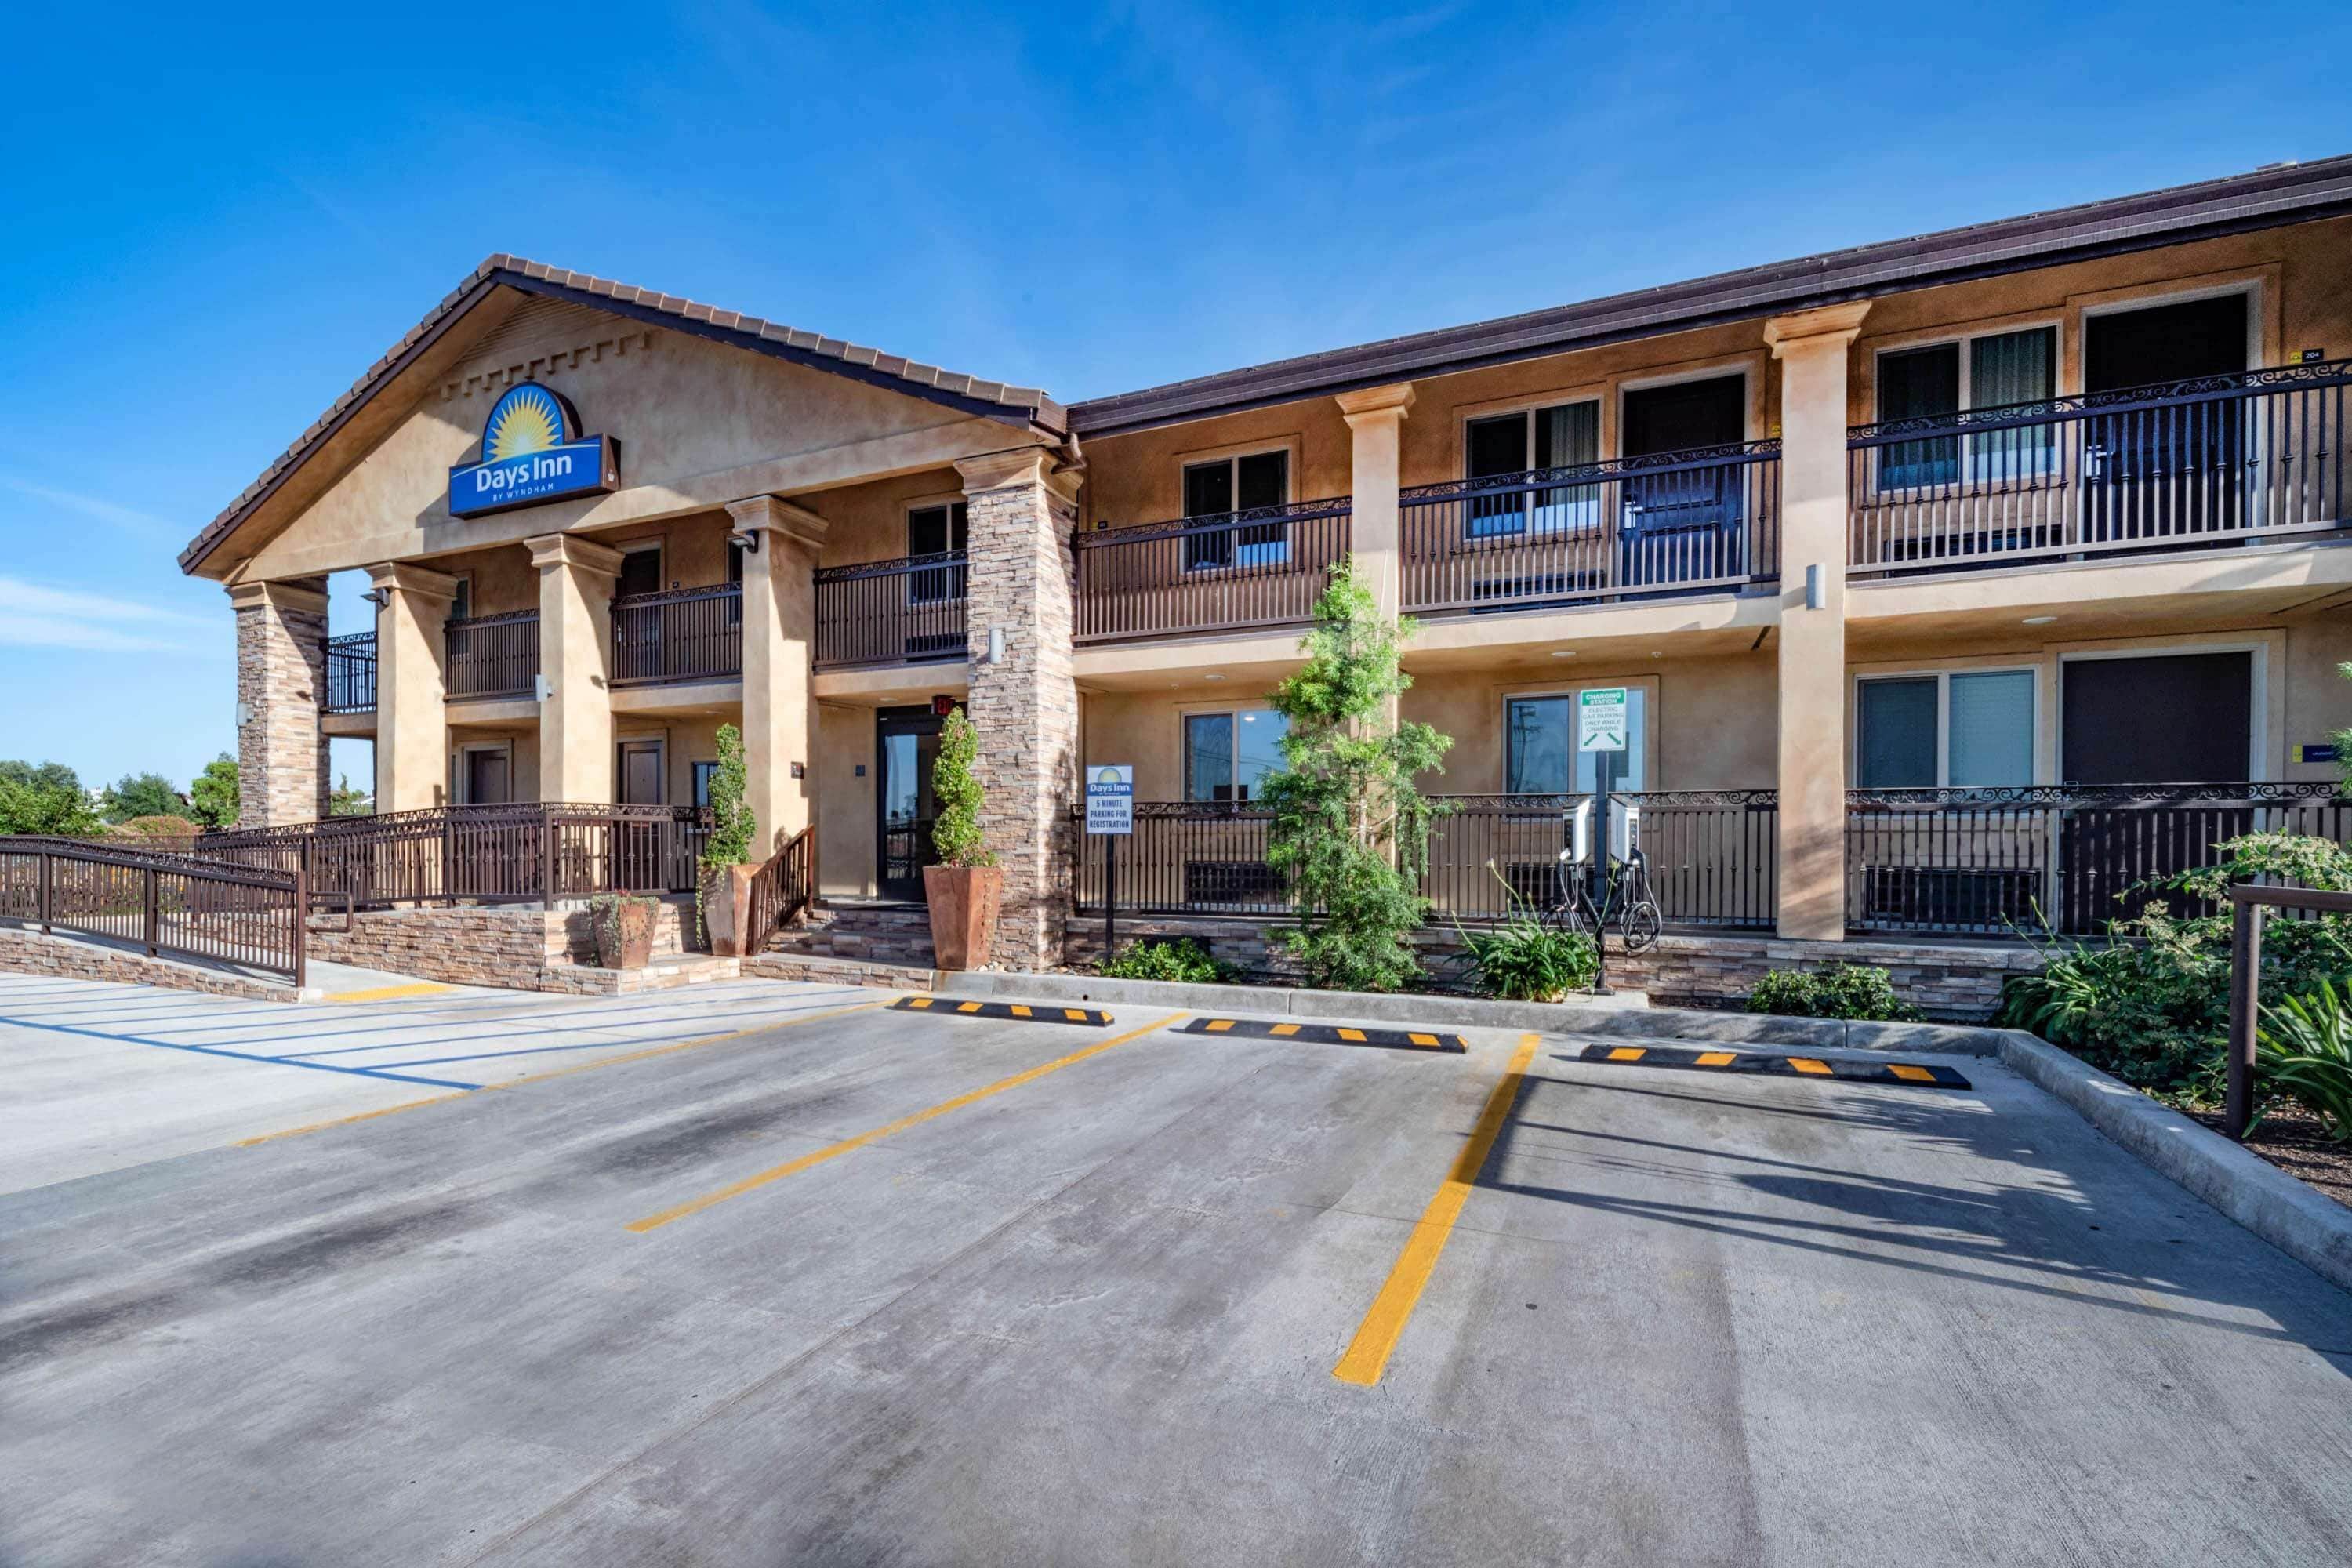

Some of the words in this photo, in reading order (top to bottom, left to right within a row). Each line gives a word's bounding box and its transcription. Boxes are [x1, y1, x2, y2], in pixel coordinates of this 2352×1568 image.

[477, 463, 530, 492] Days
[533, 455, 572, 481] Inn
[506, 482, 554, 499] WYNDHAM
[1090, 784, 1113, 793] Days
[1113, 783, 1130, 792] Inn
